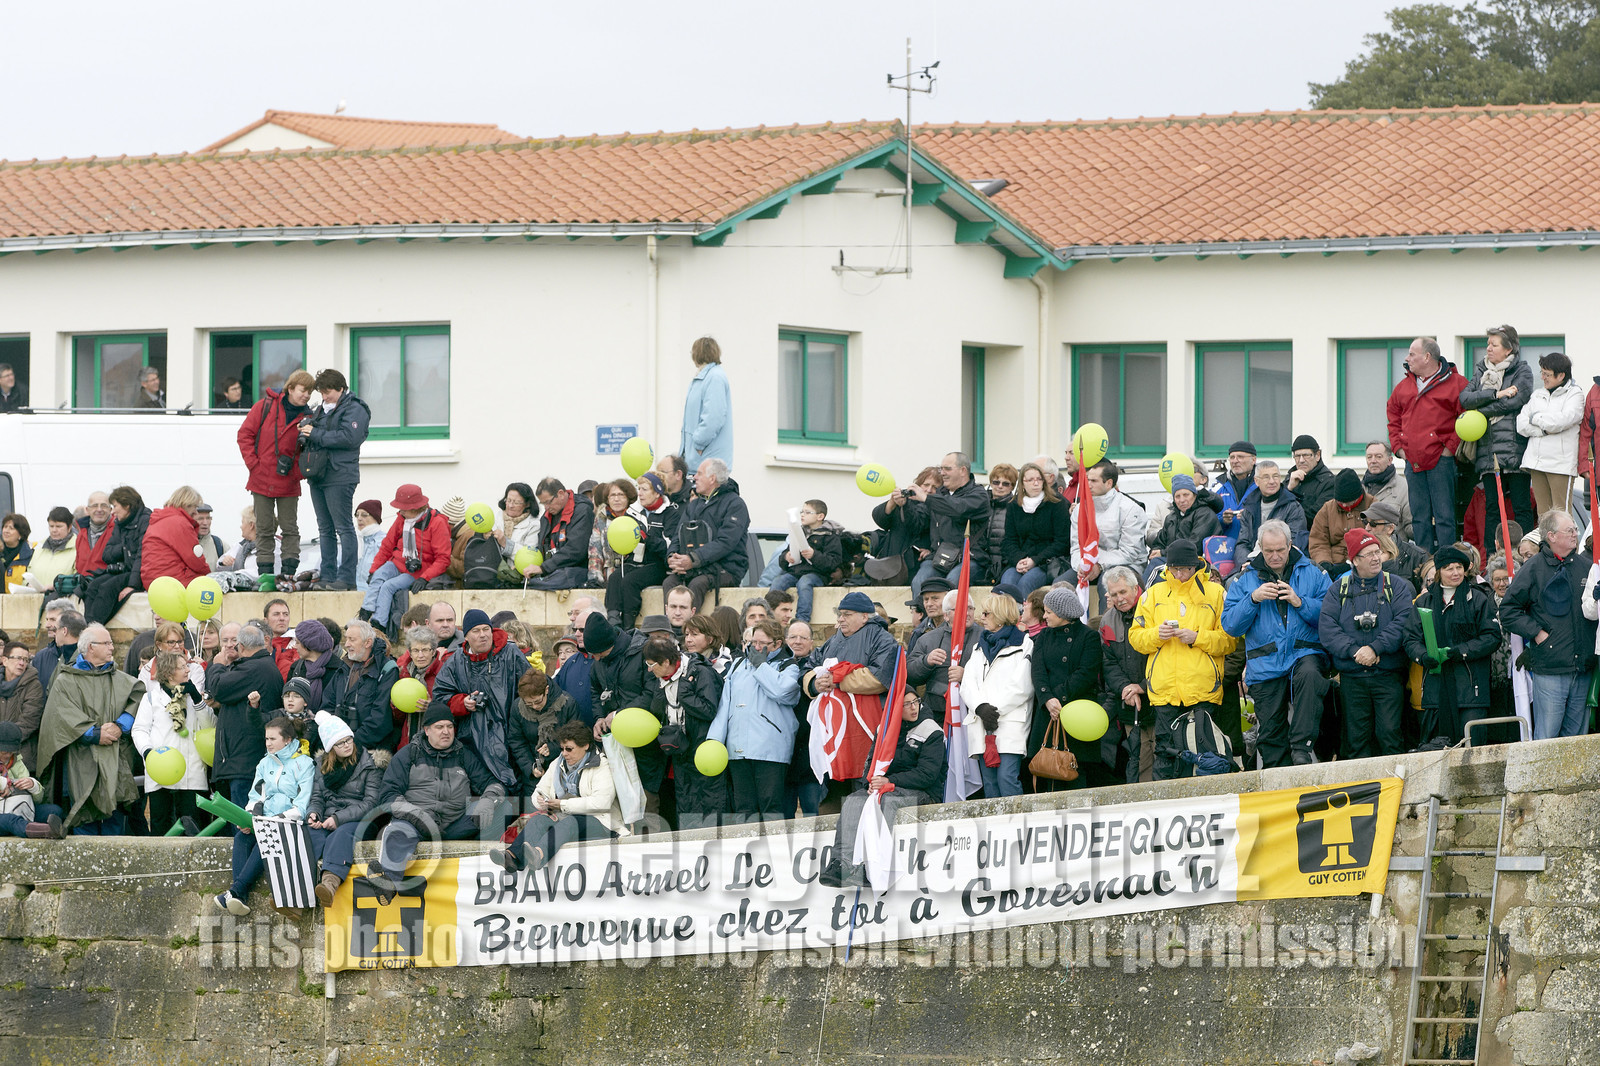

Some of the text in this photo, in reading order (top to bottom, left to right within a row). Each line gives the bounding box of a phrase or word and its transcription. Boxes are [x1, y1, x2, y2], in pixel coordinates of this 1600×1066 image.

[474, 863, 586, 905] BRAVO
[596, 855, 710, 896] Armel
[725, 852, 773, 890] Le
[977, 831, 1006, 869] du
[1017, 820, 1123, 865] VENDEE
[1130, 813, 1224, 855] GLOBE
[1308, 870, 1366, 885] GUY COTTEN
[474, 914, 695, 953] Bienvenue
[717, 898, 808, 938] chez
[831, 891, 888, 930] toi
[910, 888, 938, 924] à
[359, 959, 416, 969] GUY COTTEN
